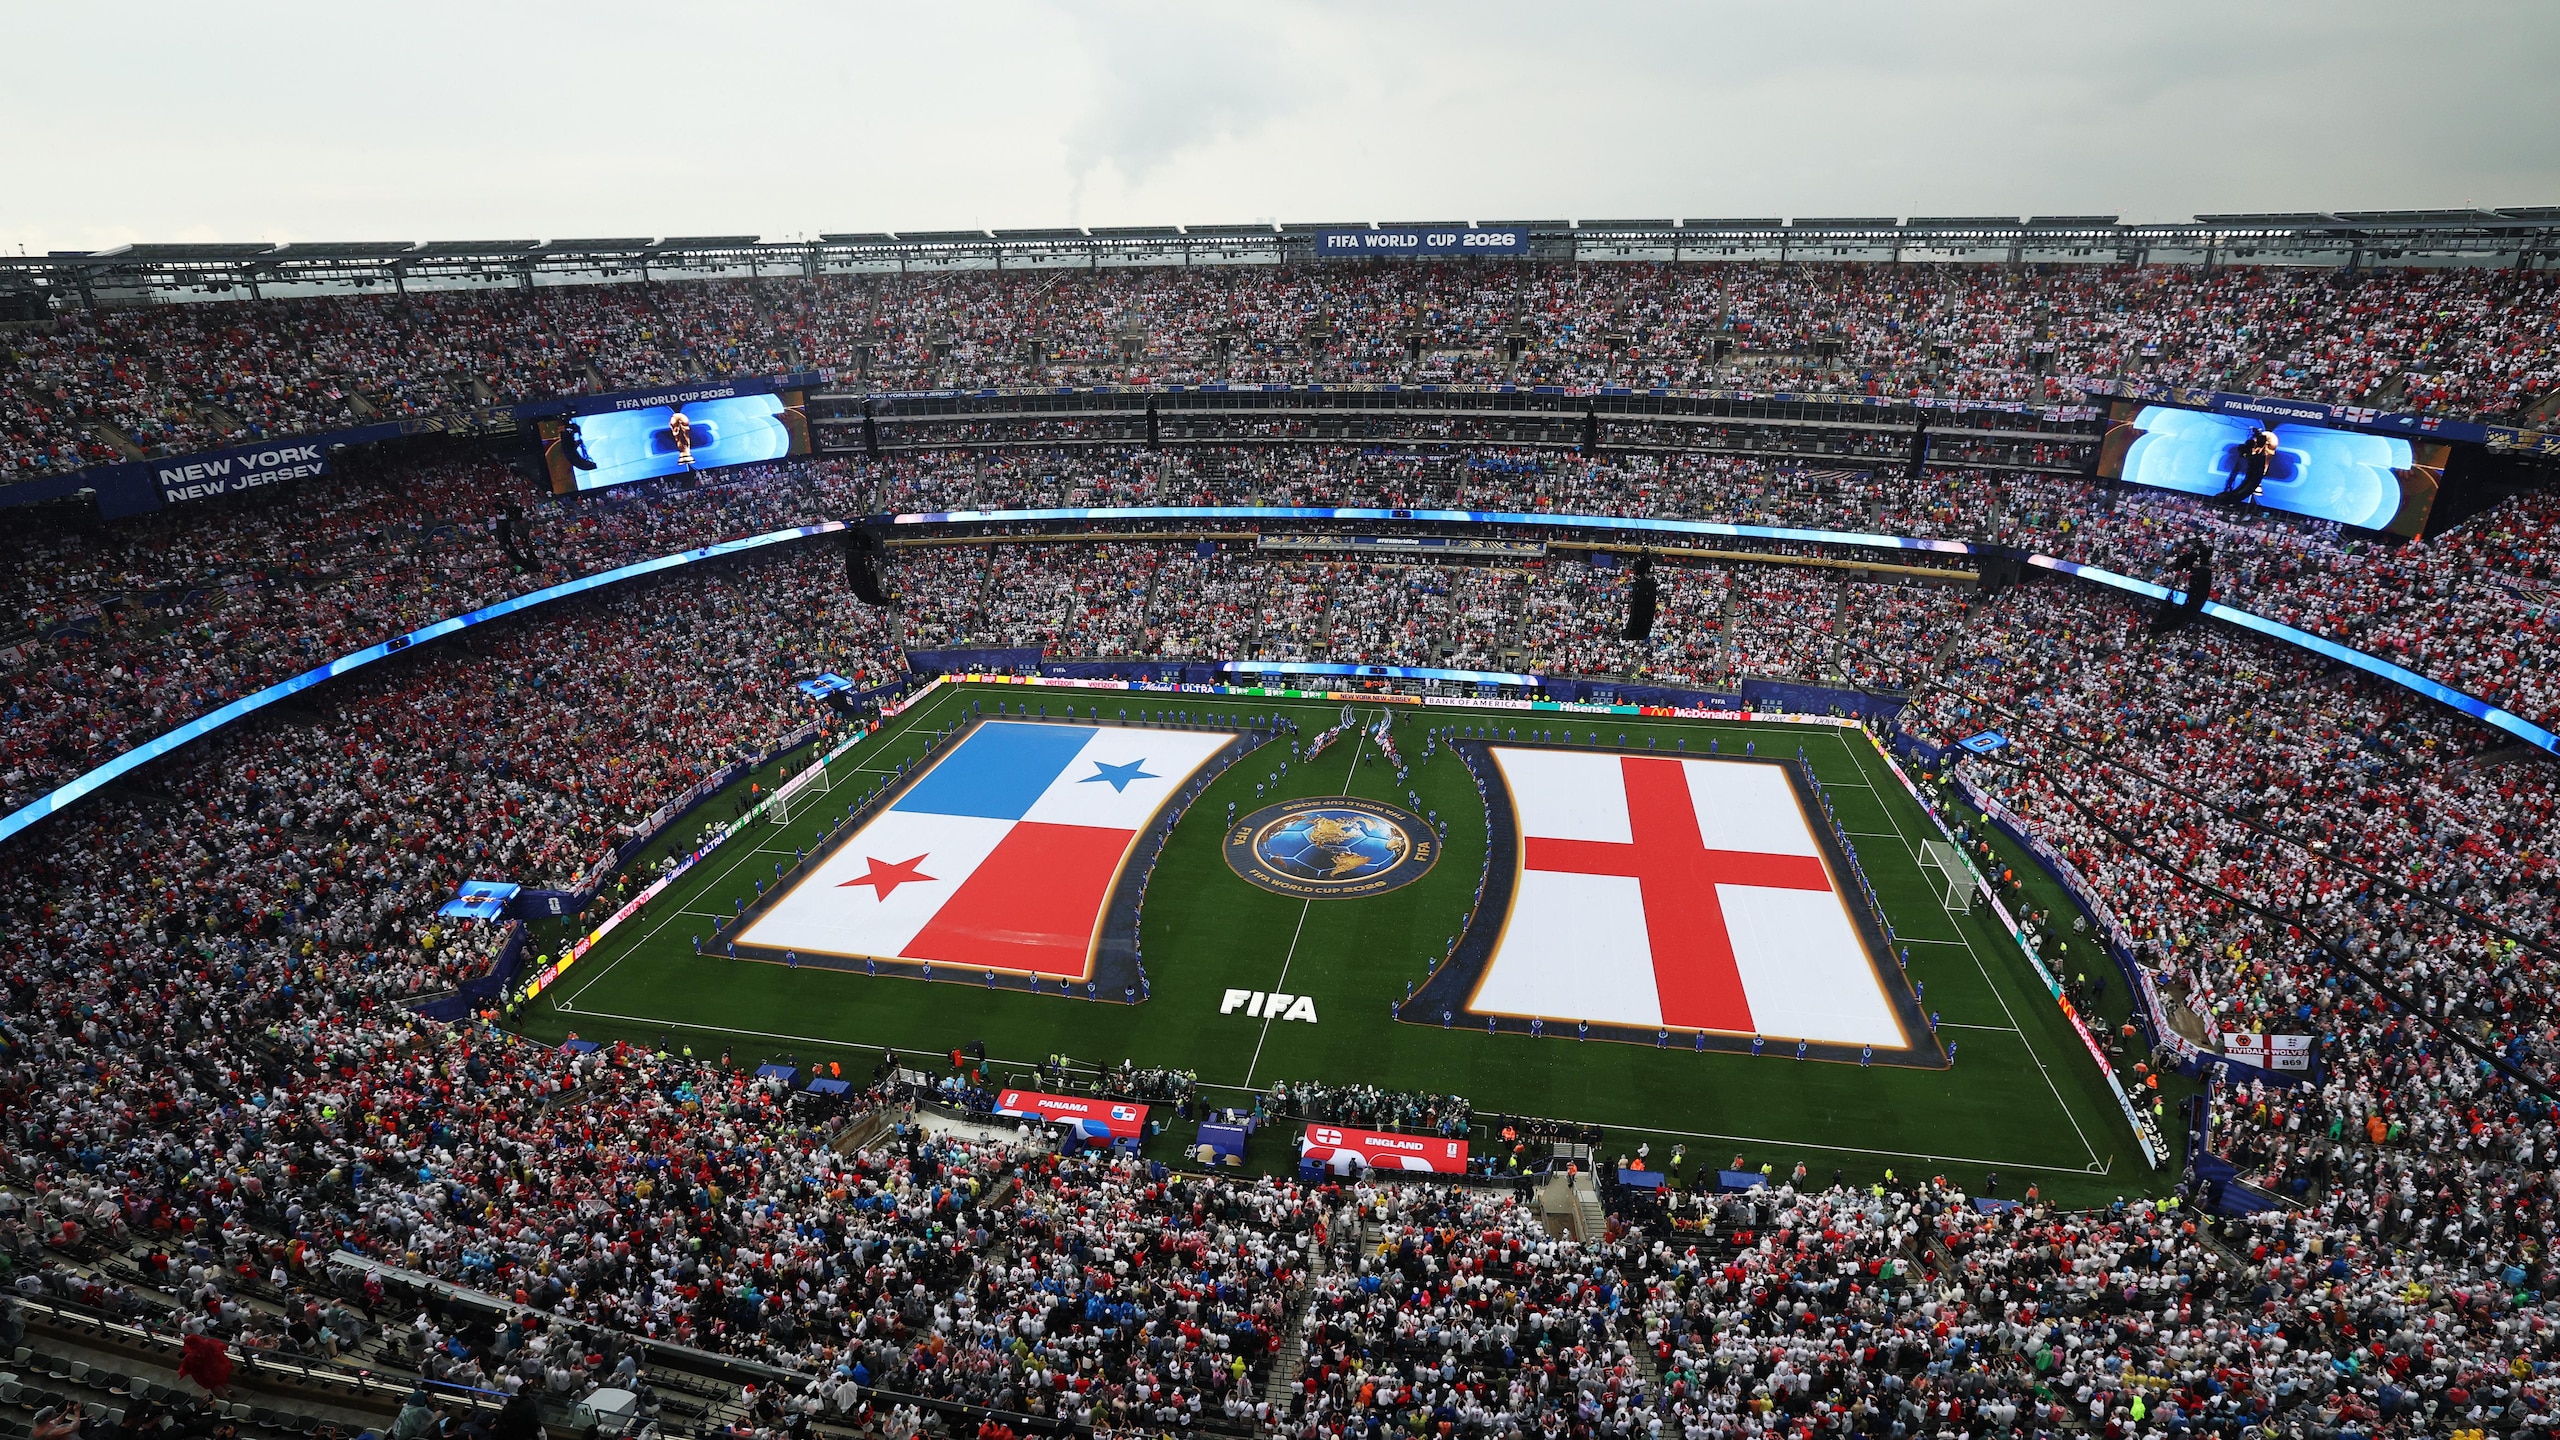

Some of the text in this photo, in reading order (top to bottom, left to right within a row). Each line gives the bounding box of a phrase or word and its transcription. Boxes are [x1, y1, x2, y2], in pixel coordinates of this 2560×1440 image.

[1327, 233, 1516, 248] FIFA WORLD CUP 2026
[615, 387, 735, 410] FIFA WORLD CUP 2026
[2224, 400, 2324, 420] FIFA WORLD CUP 2026
[159, 444, 322, 486] NEW YORK
[166, 462, 323, 503] NEW JERSEY
[1044, 678, 1075, 687] verizon
[1088, 680, 1118, 689] verizon
[1139, 682, 1215, 694] Michelob ULTRA
[1429, 697, 1517, 708] BANK OF AMERICA
[1559, 702, 1612, 714] Hisense
[1711, 698, 1726, 706] FIFA
[1673, 708, 1741, 721] McDonald's
[1762, 714, 1785, 722] Dove
[1813, 717, 1838, 726] Dove
[829, 735, 860, 761] Hisense
[1346, 800, 1385, 812] WORLD
[1383, 808, 1406, 821] FIFA
[1232, 826, 1253, 847] FIFA
[699, 833, 726, 857] ULTRA
[1413, 841, 1431, 862] FIFA
[1249, 868, 1271, 883] FIFA
[1271, 878, 1311, 894] WORLD
[1342, 880, 1388, 894] 2026
[617, 892, 651, 922] verizon
[2021, 935, 2054, 990] Hisense
[1219, 988, 1318, 1024] FIFA
[2070, 1014, 2109, 1075] McDonald's
[2227, 1047, 2270, 1056] TIVIDALE
[1037, 1099, 1089, 1113] PANAMA
[2119, 1094, 2136, 1122] Dove
[1364, 1137, 1424, 1151] ENGLAND
